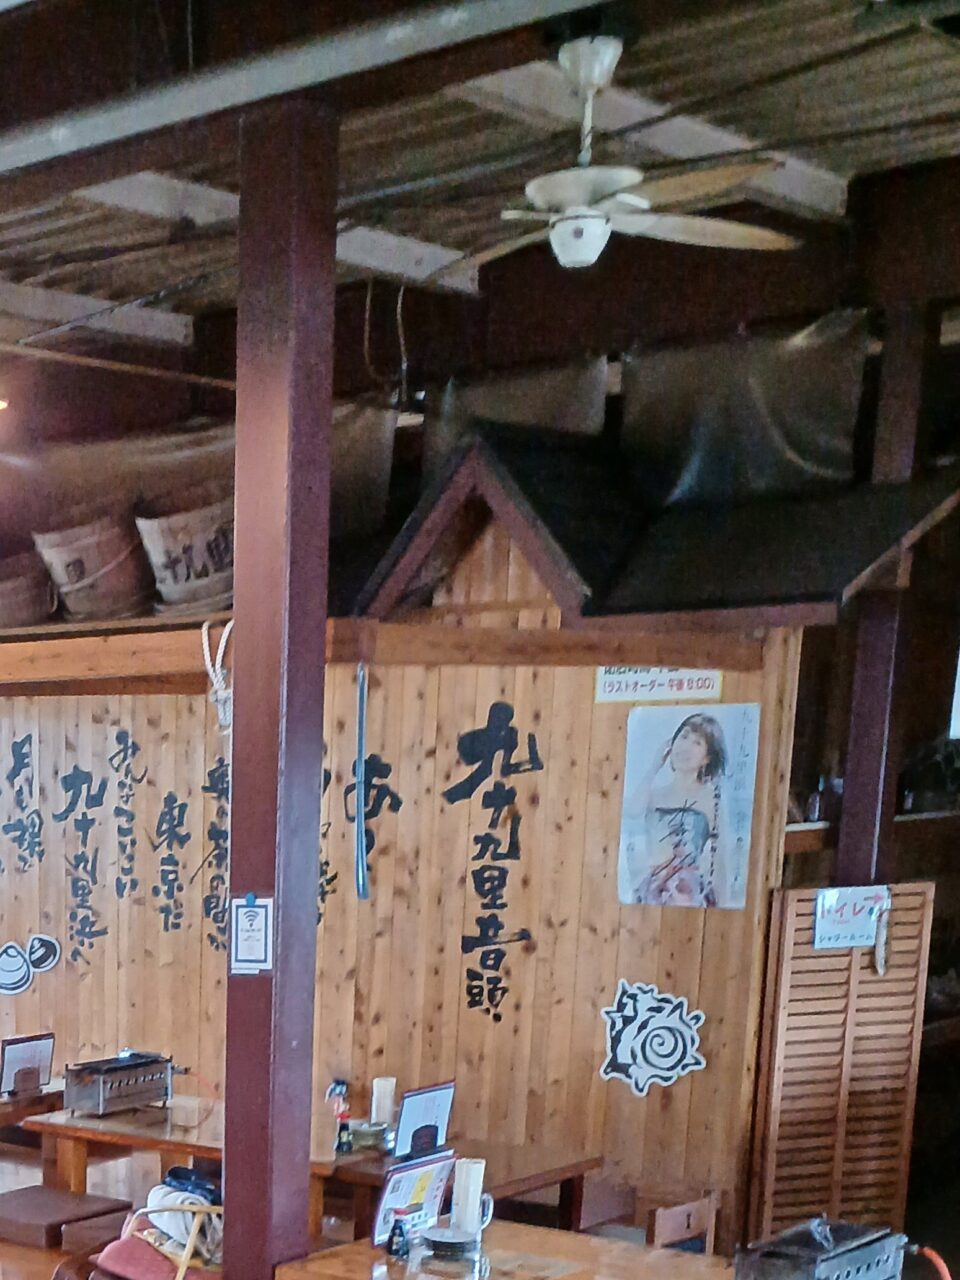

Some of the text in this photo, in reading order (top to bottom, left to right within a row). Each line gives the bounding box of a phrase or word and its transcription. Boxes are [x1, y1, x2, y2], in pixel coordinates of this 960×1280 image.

[147, 791, 191, 932] 東京だ
[441, 702, 543, 1023] 九十九里音頭
